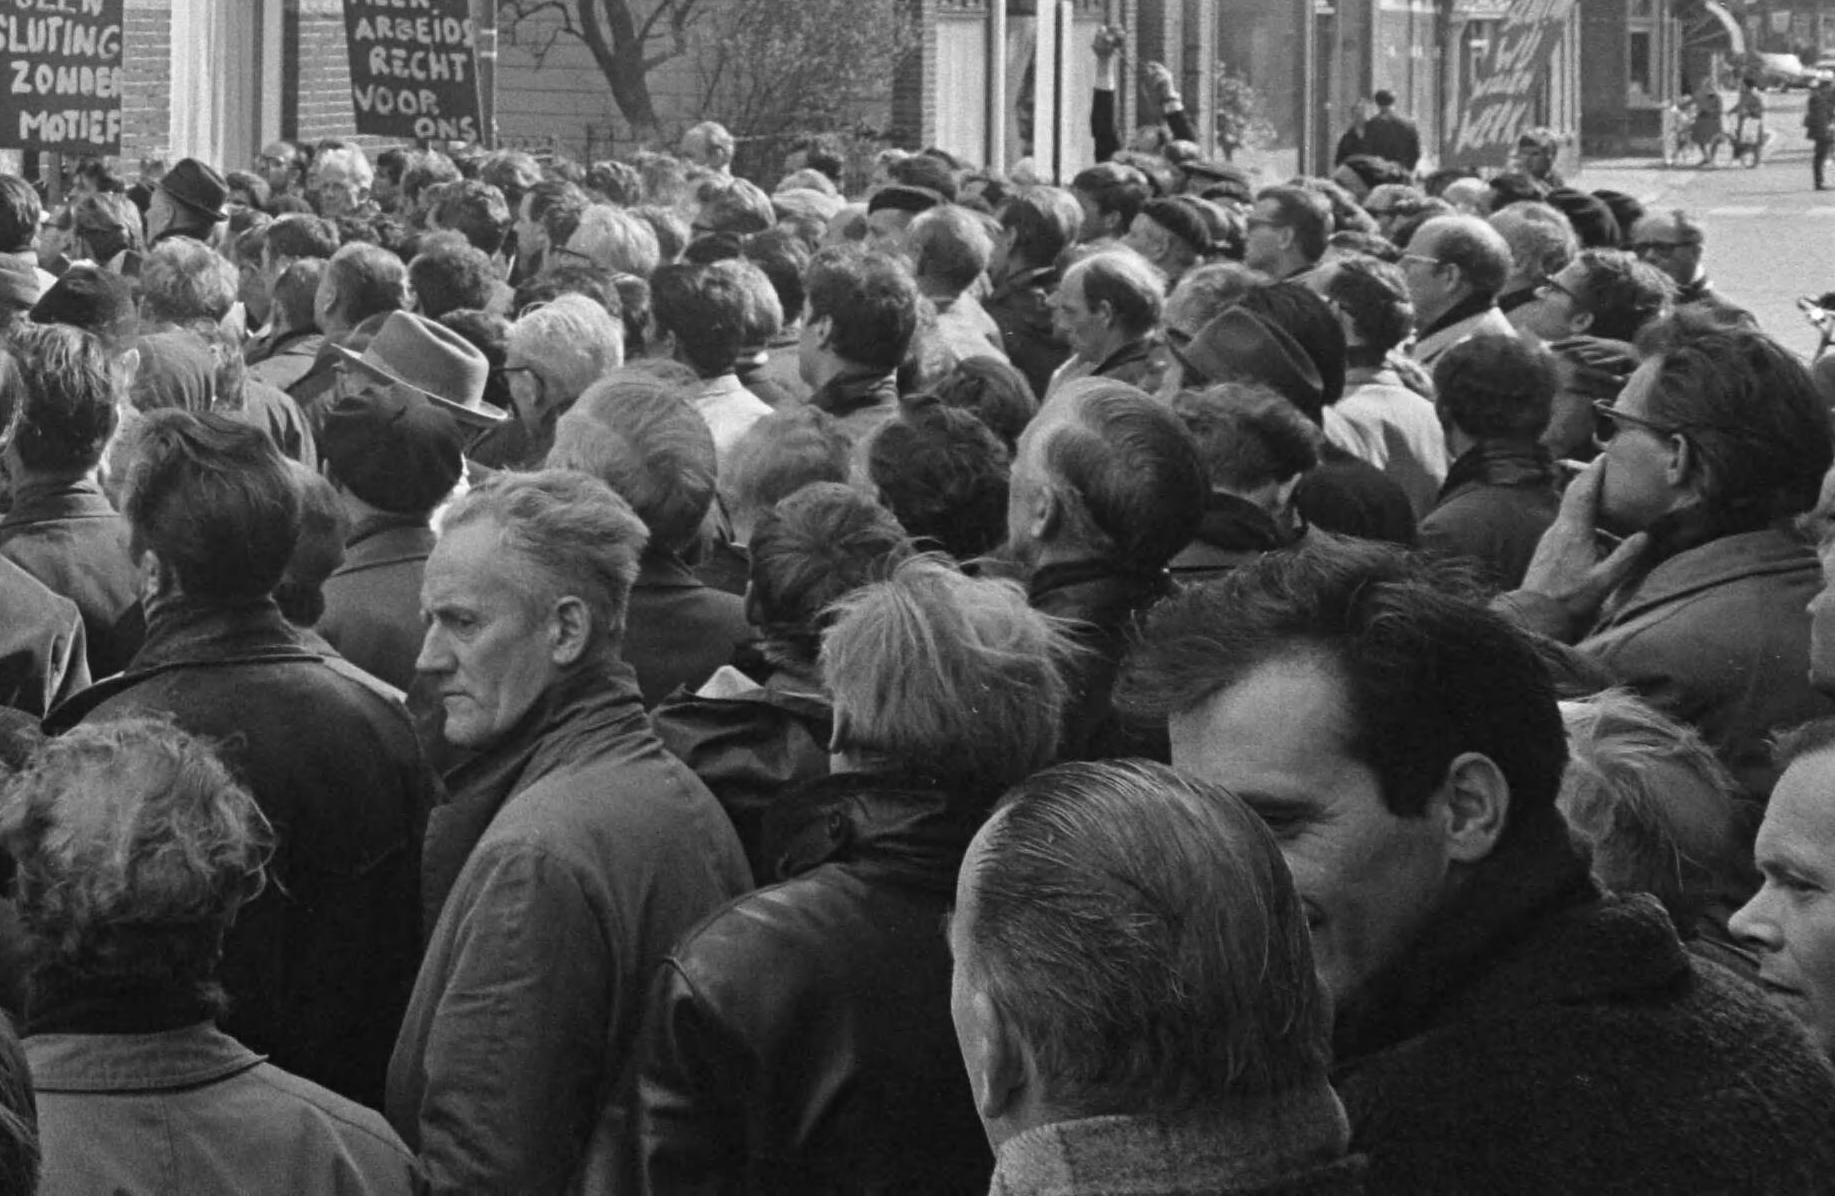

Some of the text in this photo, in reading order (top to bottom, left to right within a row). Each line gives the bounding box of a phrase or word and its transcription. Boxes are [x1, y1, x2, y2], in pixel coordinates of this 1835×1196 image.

[368, 49, 468, 87] RECHT
[354, 88, 440, 120] VOOR
[19, 109, 121, 145] MOTIEF
[414, 115, 478, 148] ONS
